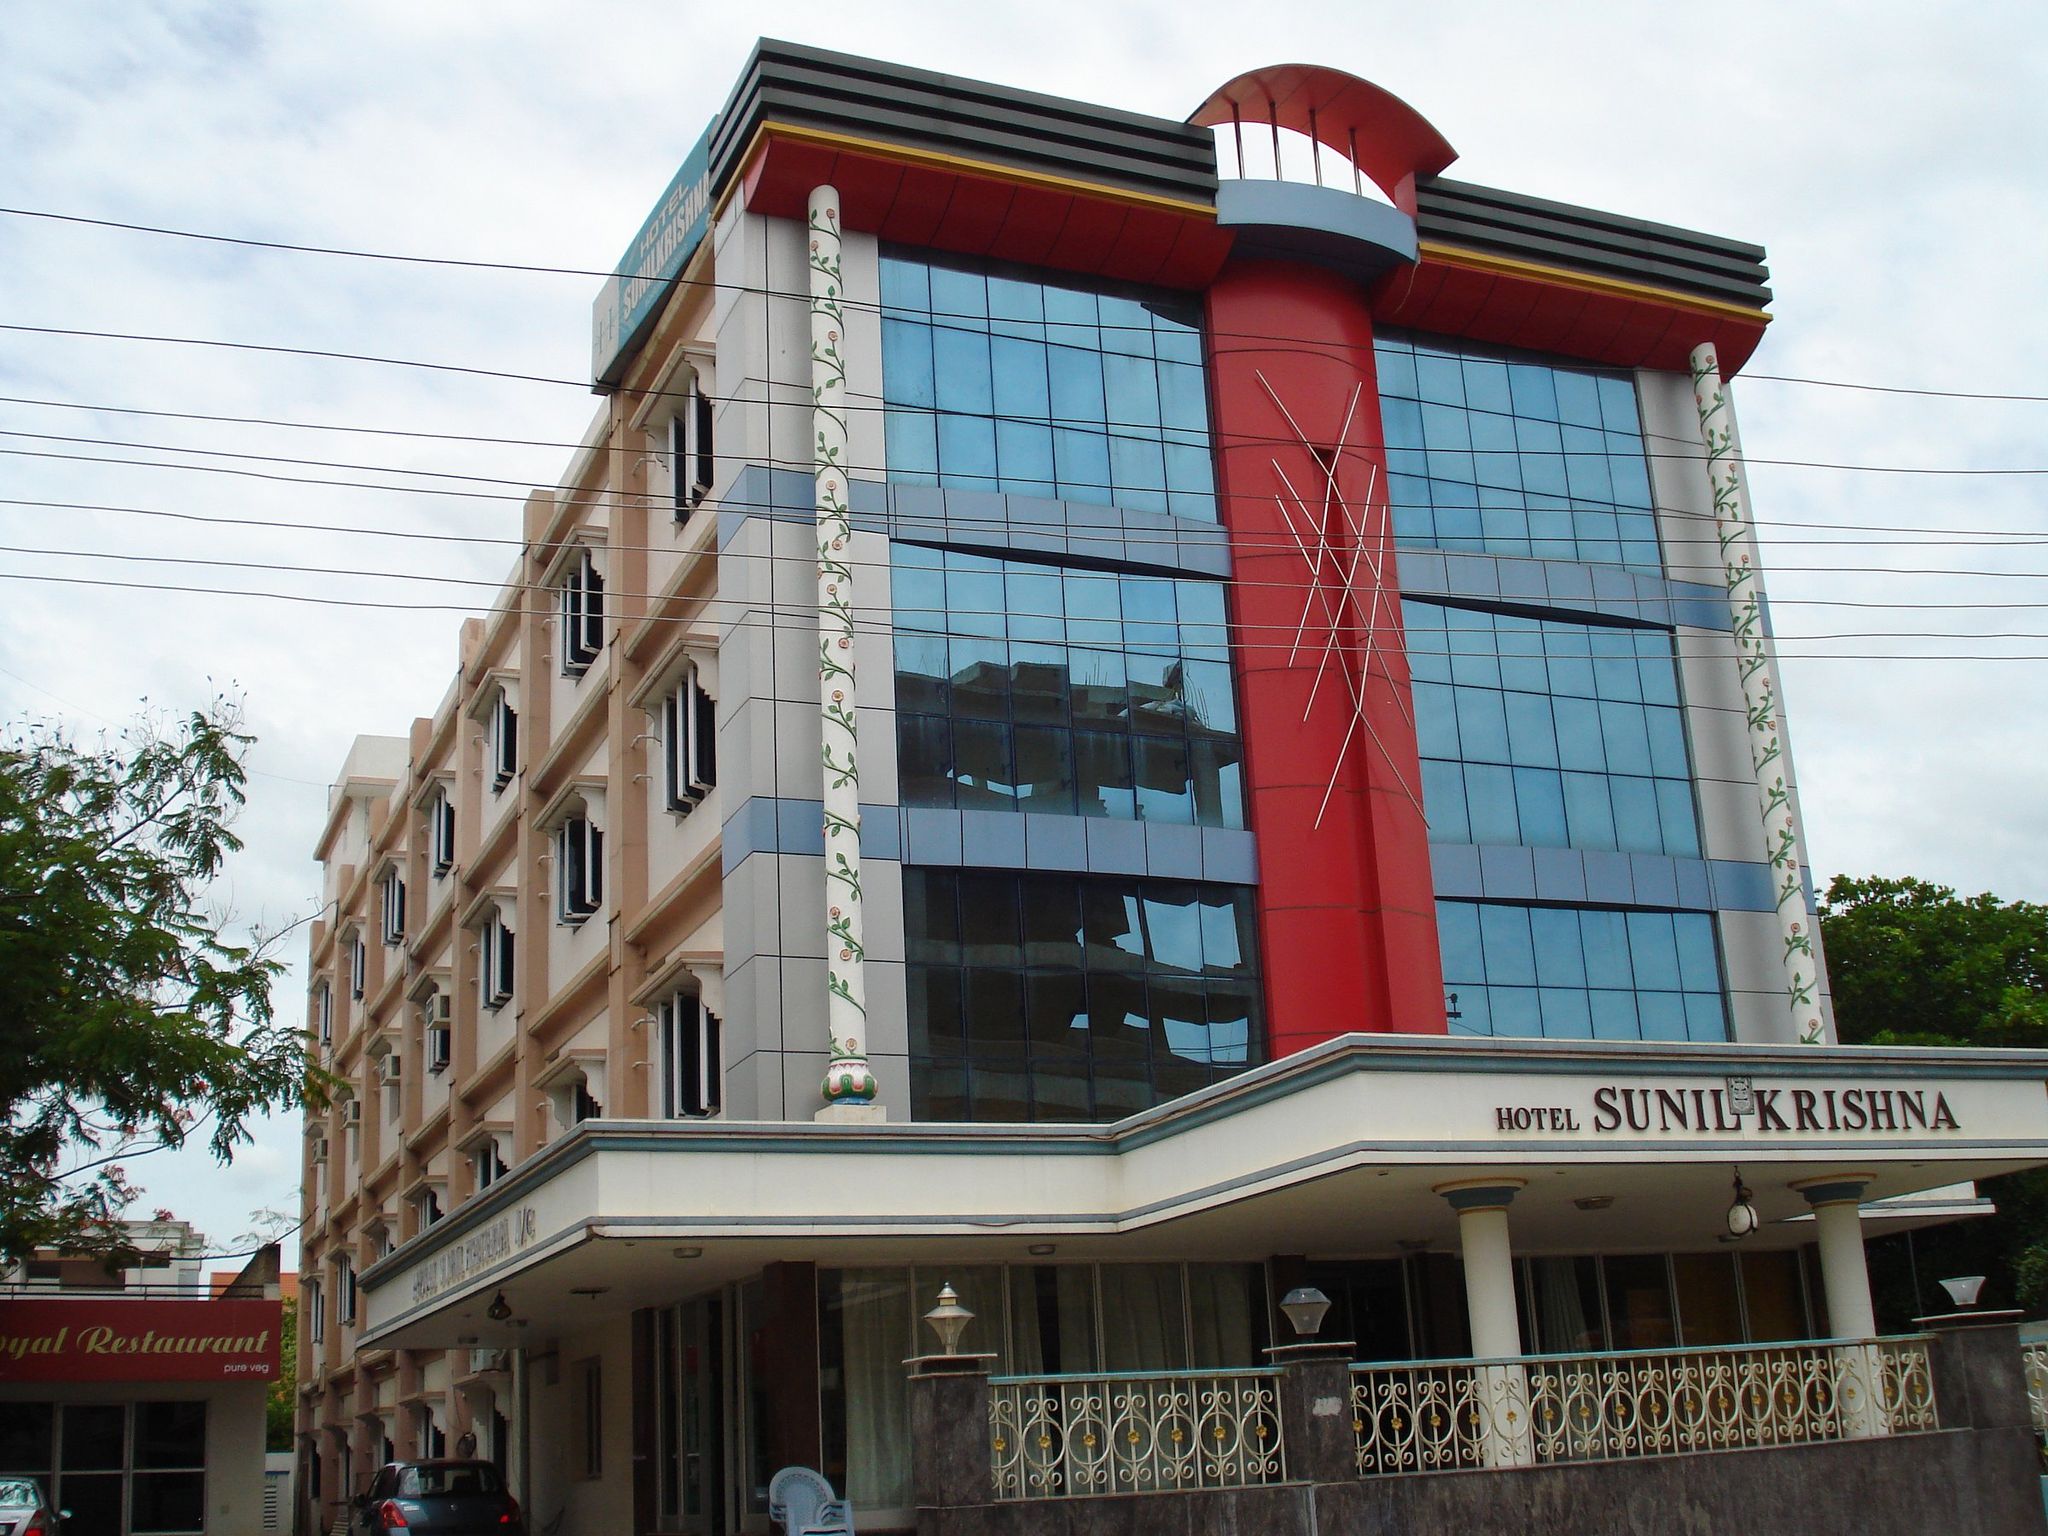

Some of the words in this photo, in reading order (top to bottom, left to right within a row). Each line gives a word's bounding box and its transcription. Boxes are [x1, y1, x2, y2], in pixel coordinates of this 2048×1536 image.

[640, 182, 690, 258] HOTEL
[1496, 1106, 1580, 1132] HOTEL
[76, 1326, 269, 1354] Restaurant
[223, 1364, 247, 1374] pure
